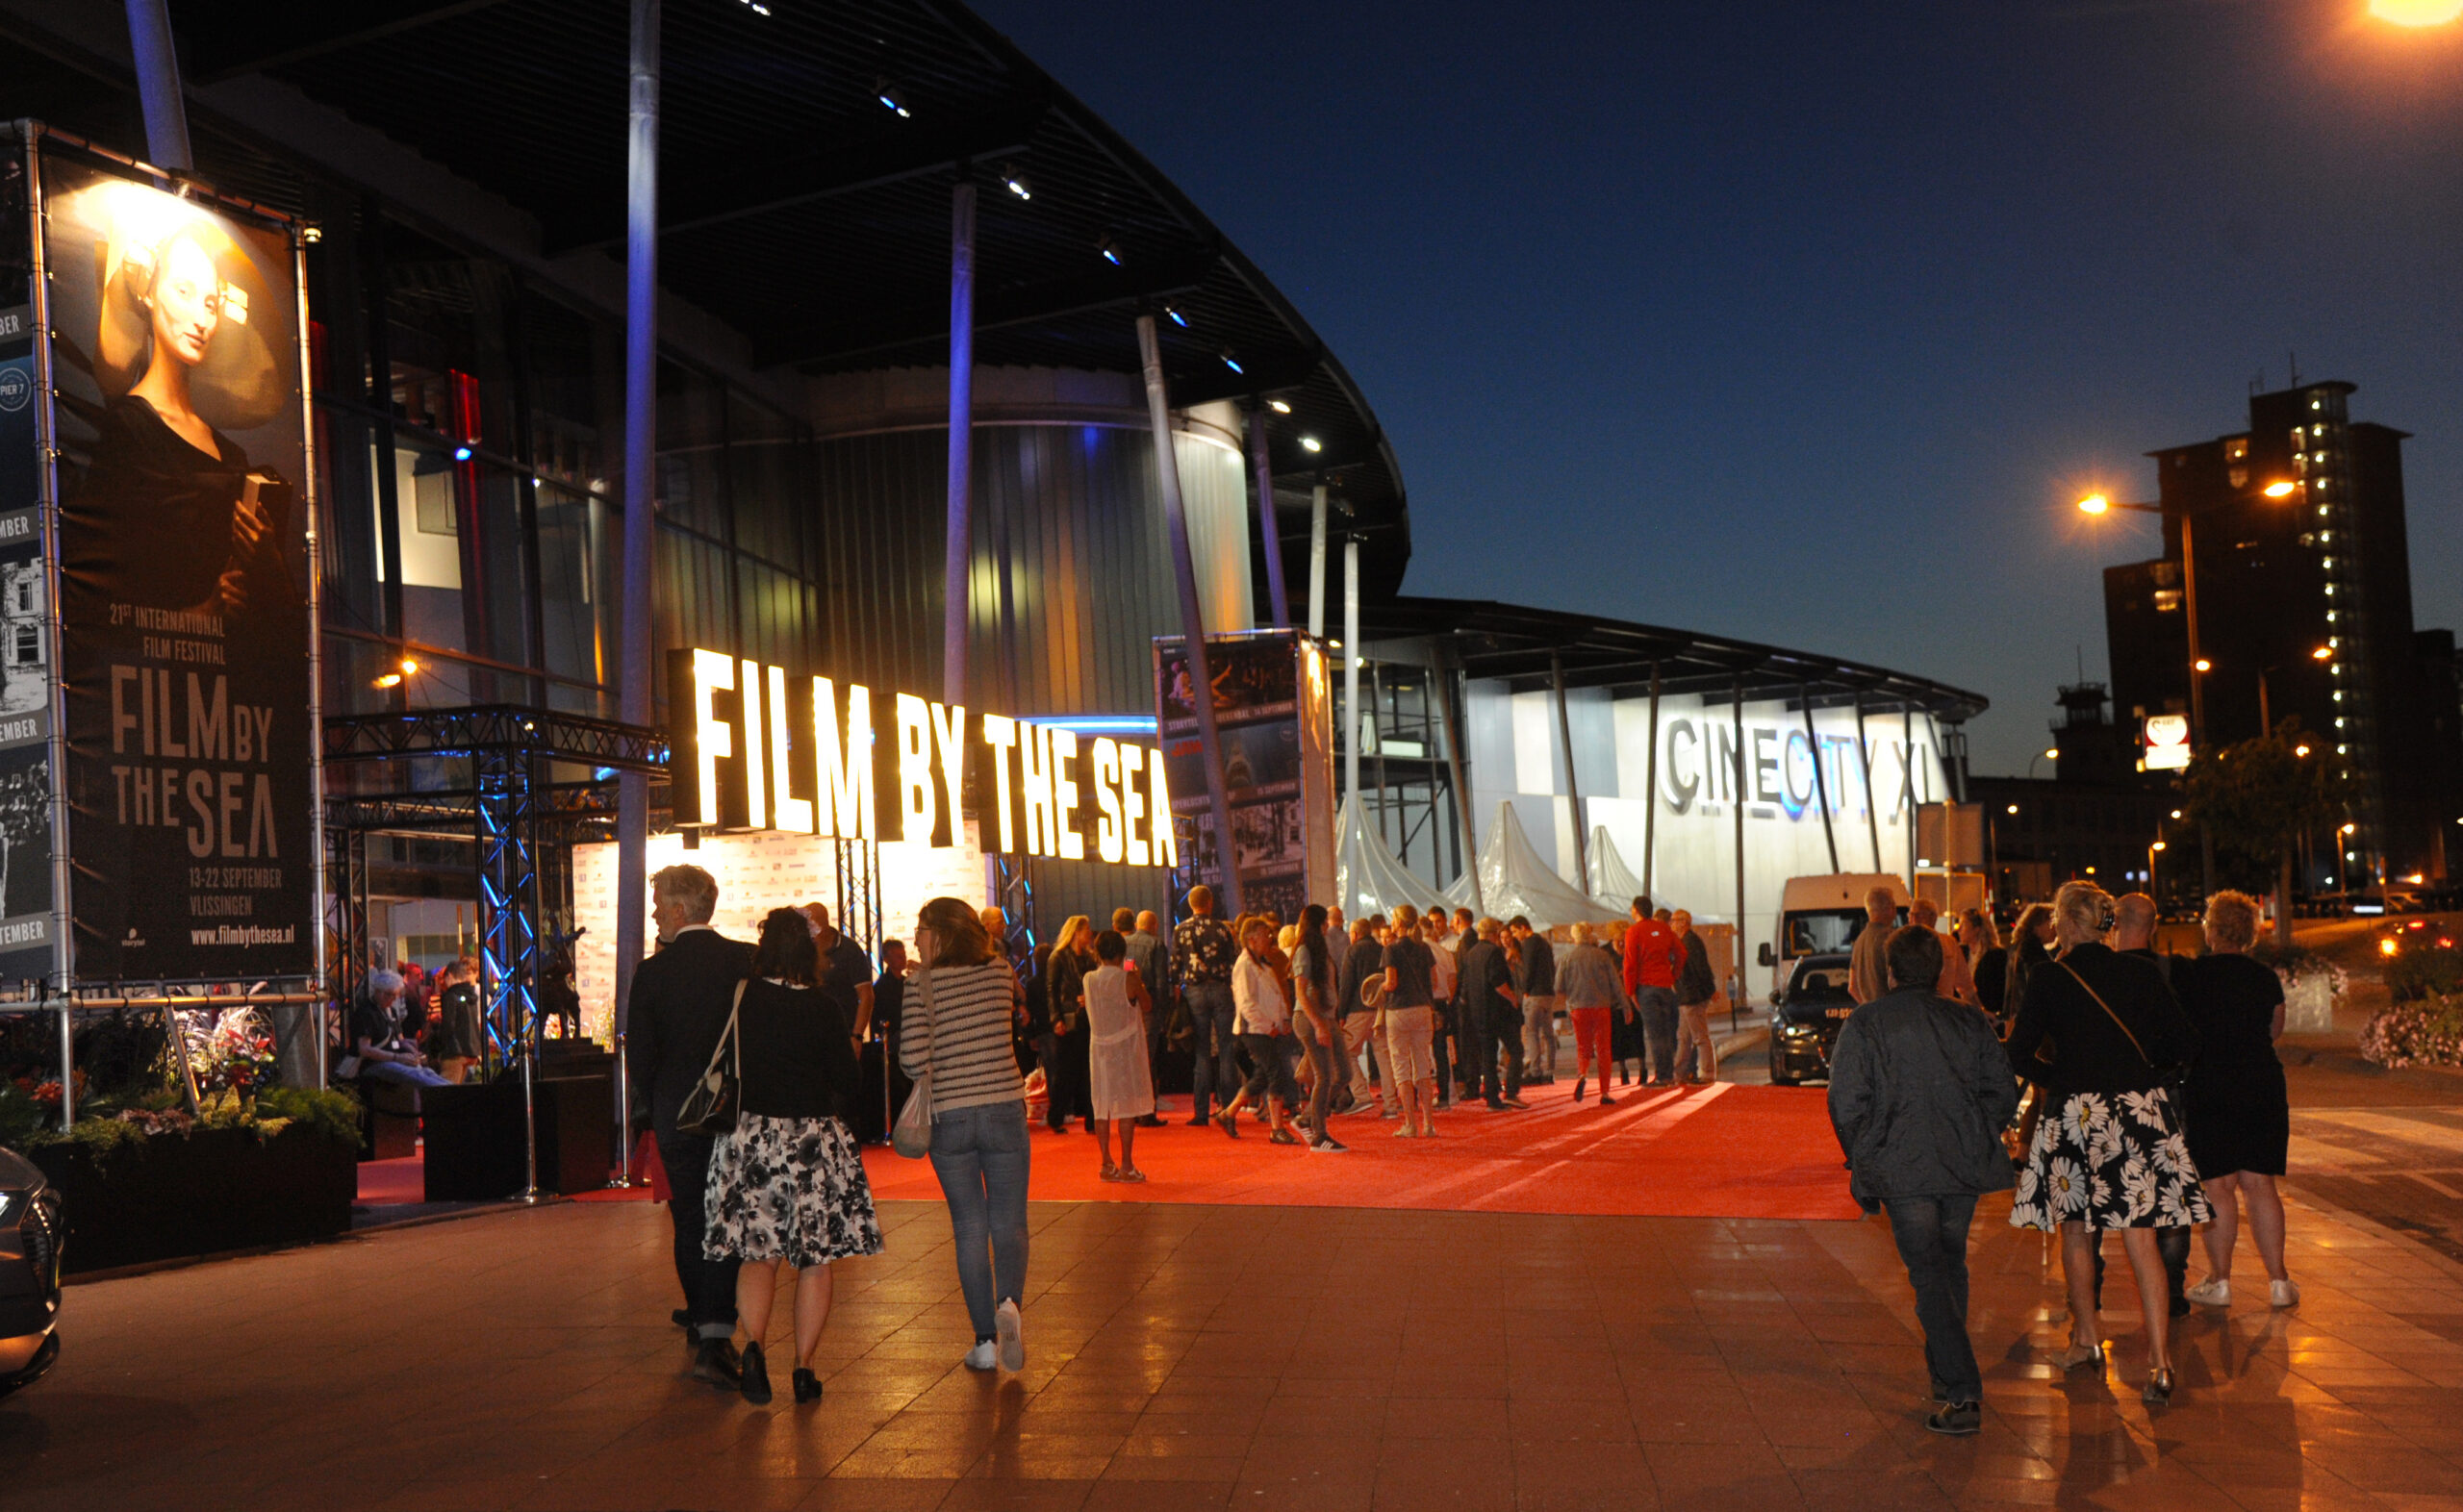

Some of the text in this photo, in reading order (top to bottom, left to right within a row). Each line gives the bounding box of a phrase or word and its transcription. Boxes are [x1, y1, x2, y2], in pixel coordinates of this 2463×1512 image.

[0, 384, 24, 396] PIER 7
[110, 603, 226, 638] 21ST INTERNATIONAL
[143, 636, 226, 665] FILM FESTIVAL
[111, 664, 273, 763] FILM BY
[694, 648, 1179, 868] FILM BY THE SEA
[111, 766, 278, 859] THE SEA
[189, 868, 282, 890] 13-22 SEPTEMBER
[190, 895, 253, 917] VLISSINGEN
[190, 924, 295, 949] www.filmbythesea.nl
